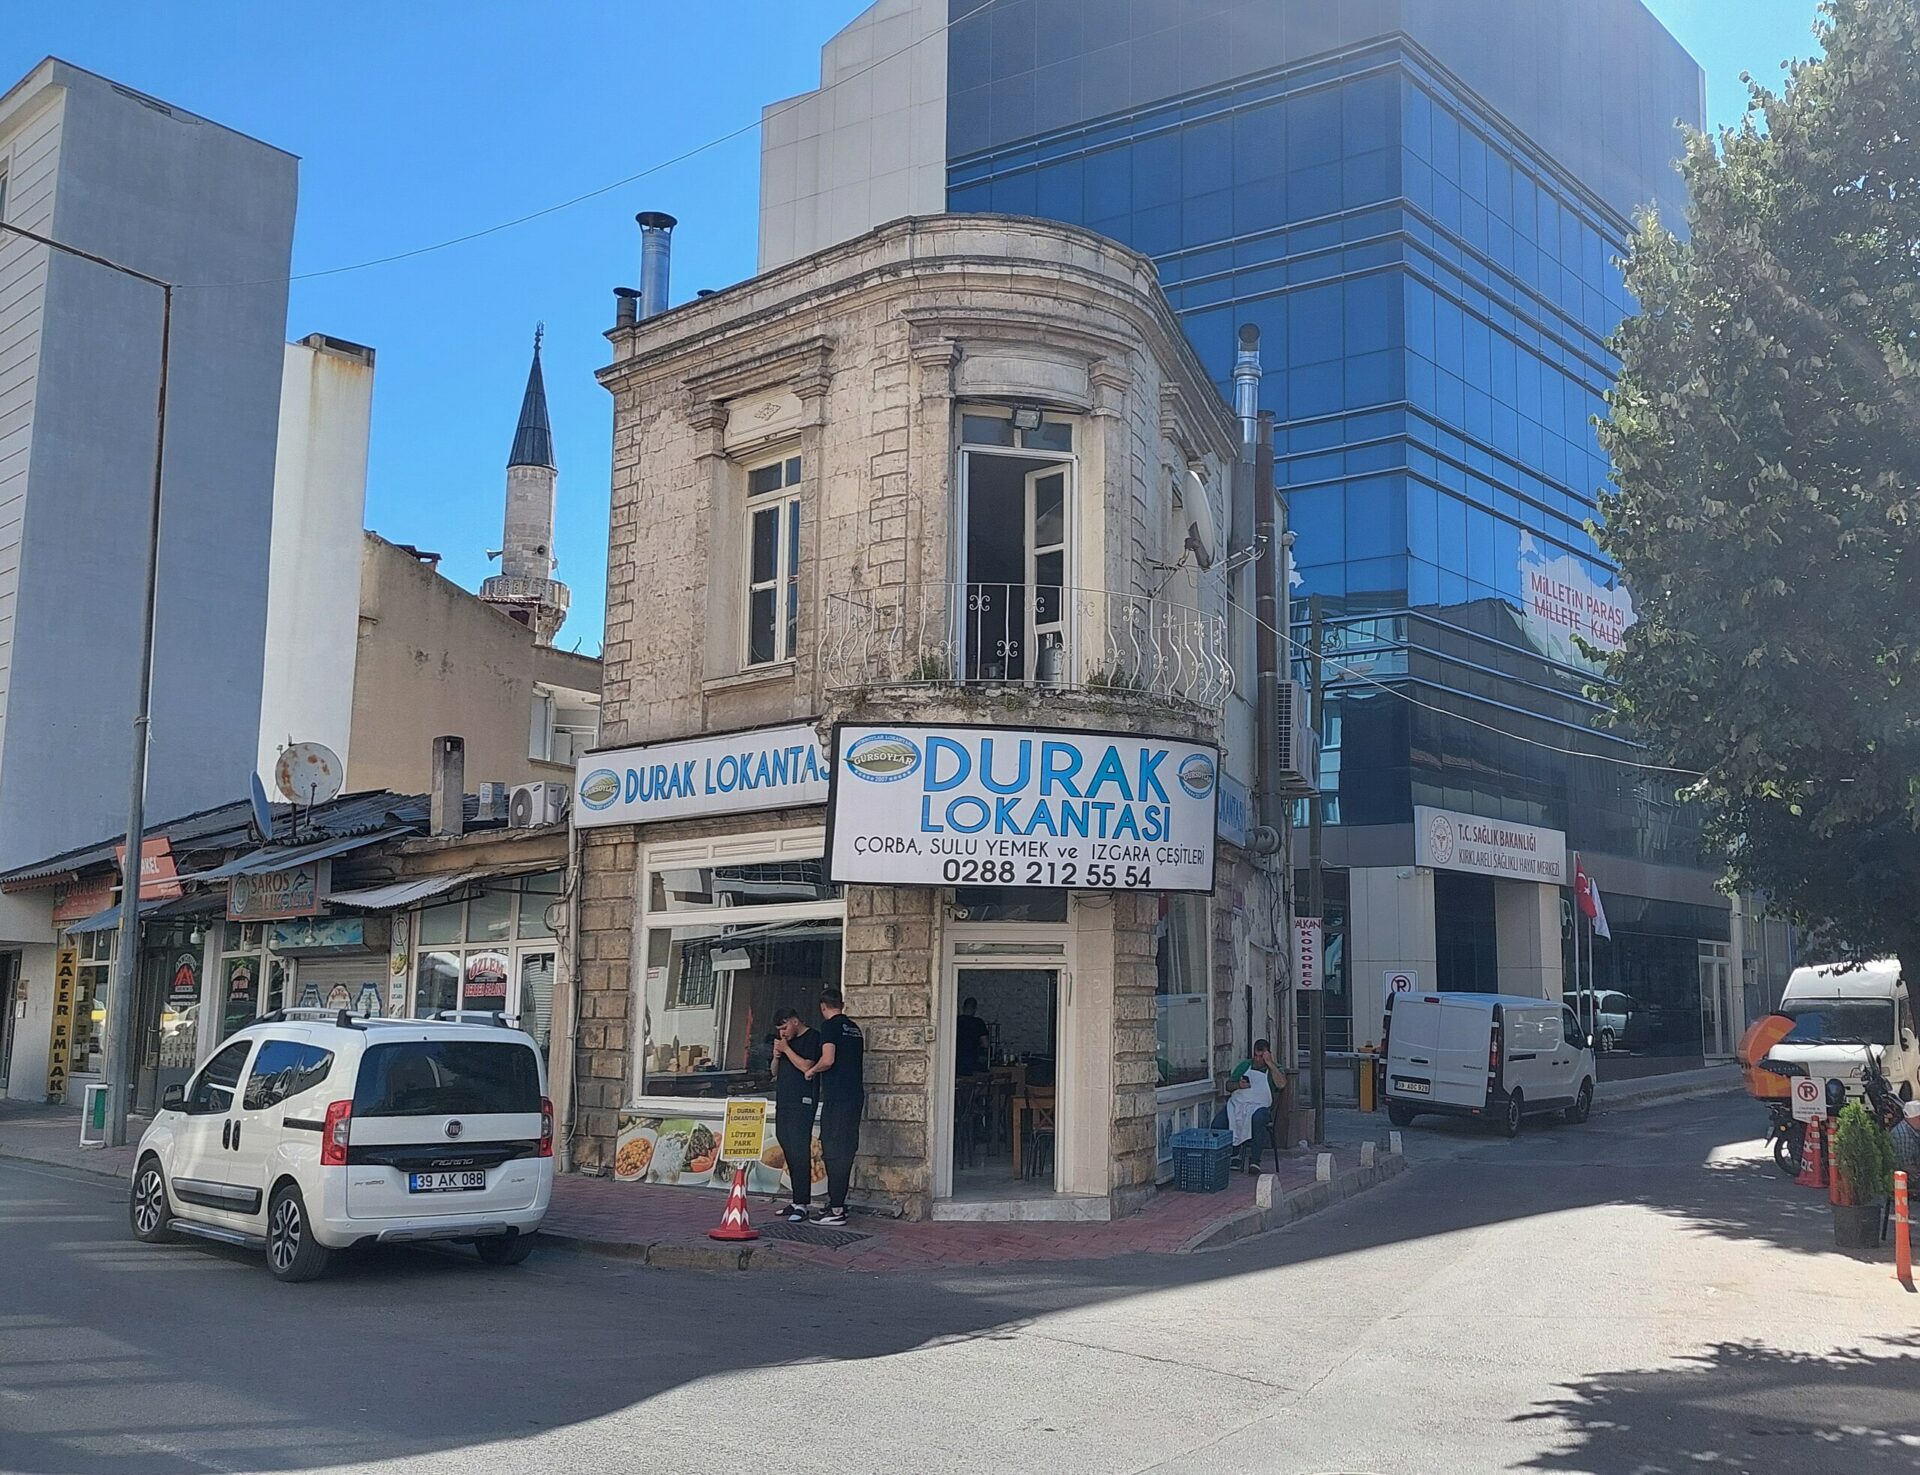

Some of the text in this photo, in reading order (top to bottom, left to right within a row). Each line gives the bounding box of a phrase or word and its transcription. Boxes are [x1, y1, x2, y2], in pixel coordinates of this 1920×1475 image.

[1587, 596, 1625, 627] PARASI
[625, 760, 696, 804] DURAK
[923, 736, 1170, 803] DURAK
[921, 795, 1171, 842] LOKANTASI
[854, 836, 1205, 867] ÇORBA, SULU YEMEK ve IZGARA ÇEŞİTLERİ
[1458, 824, 1537, 852] T.C. SAĞLIK BAKANLIĞI
[943, 858, 1151, 887] 0288 212 55 54
[1459, 848, 1493, 867] KIRKLARELİ
[1519, 858, 1537, 874] HAYAT
[1537, 860, 1560, 877] MERKEZİ
[251, 872, 290, 894] SAROS
[1301, 930, 1313, 988] KOKOREÇ
[57, 953, 73, 1016] ZAFER
[50, 1025, 67, 1091] EMLAK
[417, 1172, 483, 1188] 39 AK 088
